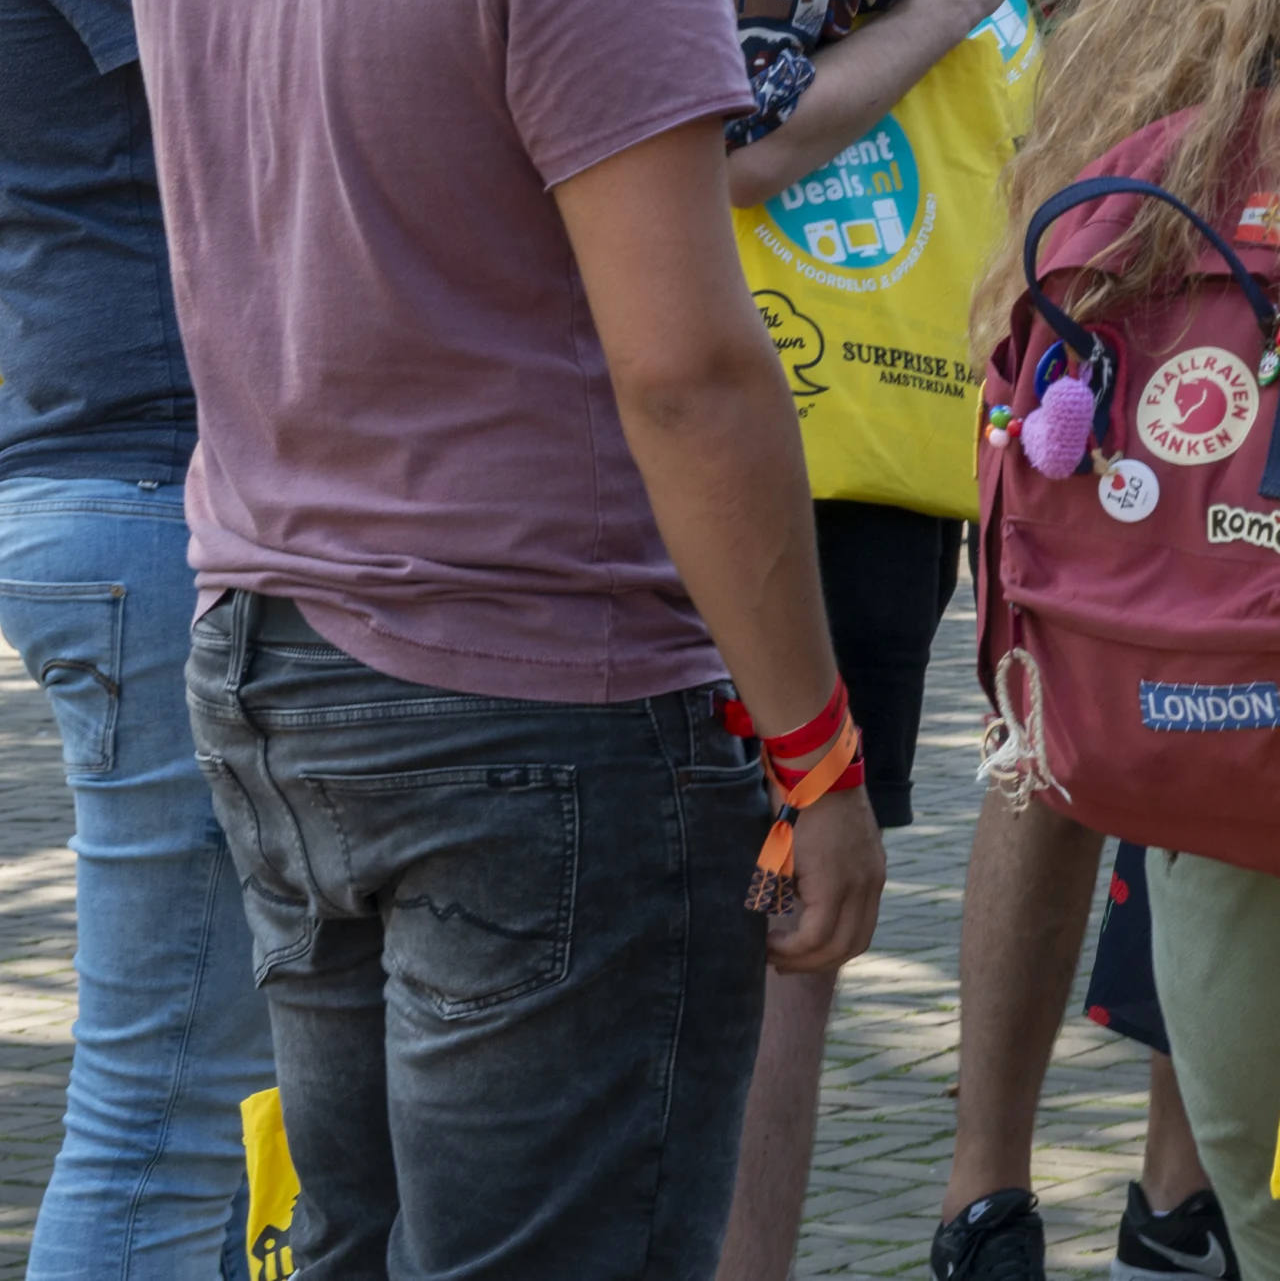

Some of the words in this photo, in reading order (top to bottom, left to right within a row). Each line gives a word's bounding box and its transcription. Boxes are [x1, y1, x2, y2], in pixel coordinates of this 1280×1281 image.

[780, 160, 904, 212] Deals.nl
[754, 223, 793, 264] HUUR
[795, 259, 878, 294] VOORDELIG
[842, 340, 949, 379] SURPRISE
[953, 361, 982, 387] BA
[878, 368, 966, 399] AMSTERDAM
[1120, 474, 1144, 510] VLC
[1147, 691, 1276, 723] LONDON
